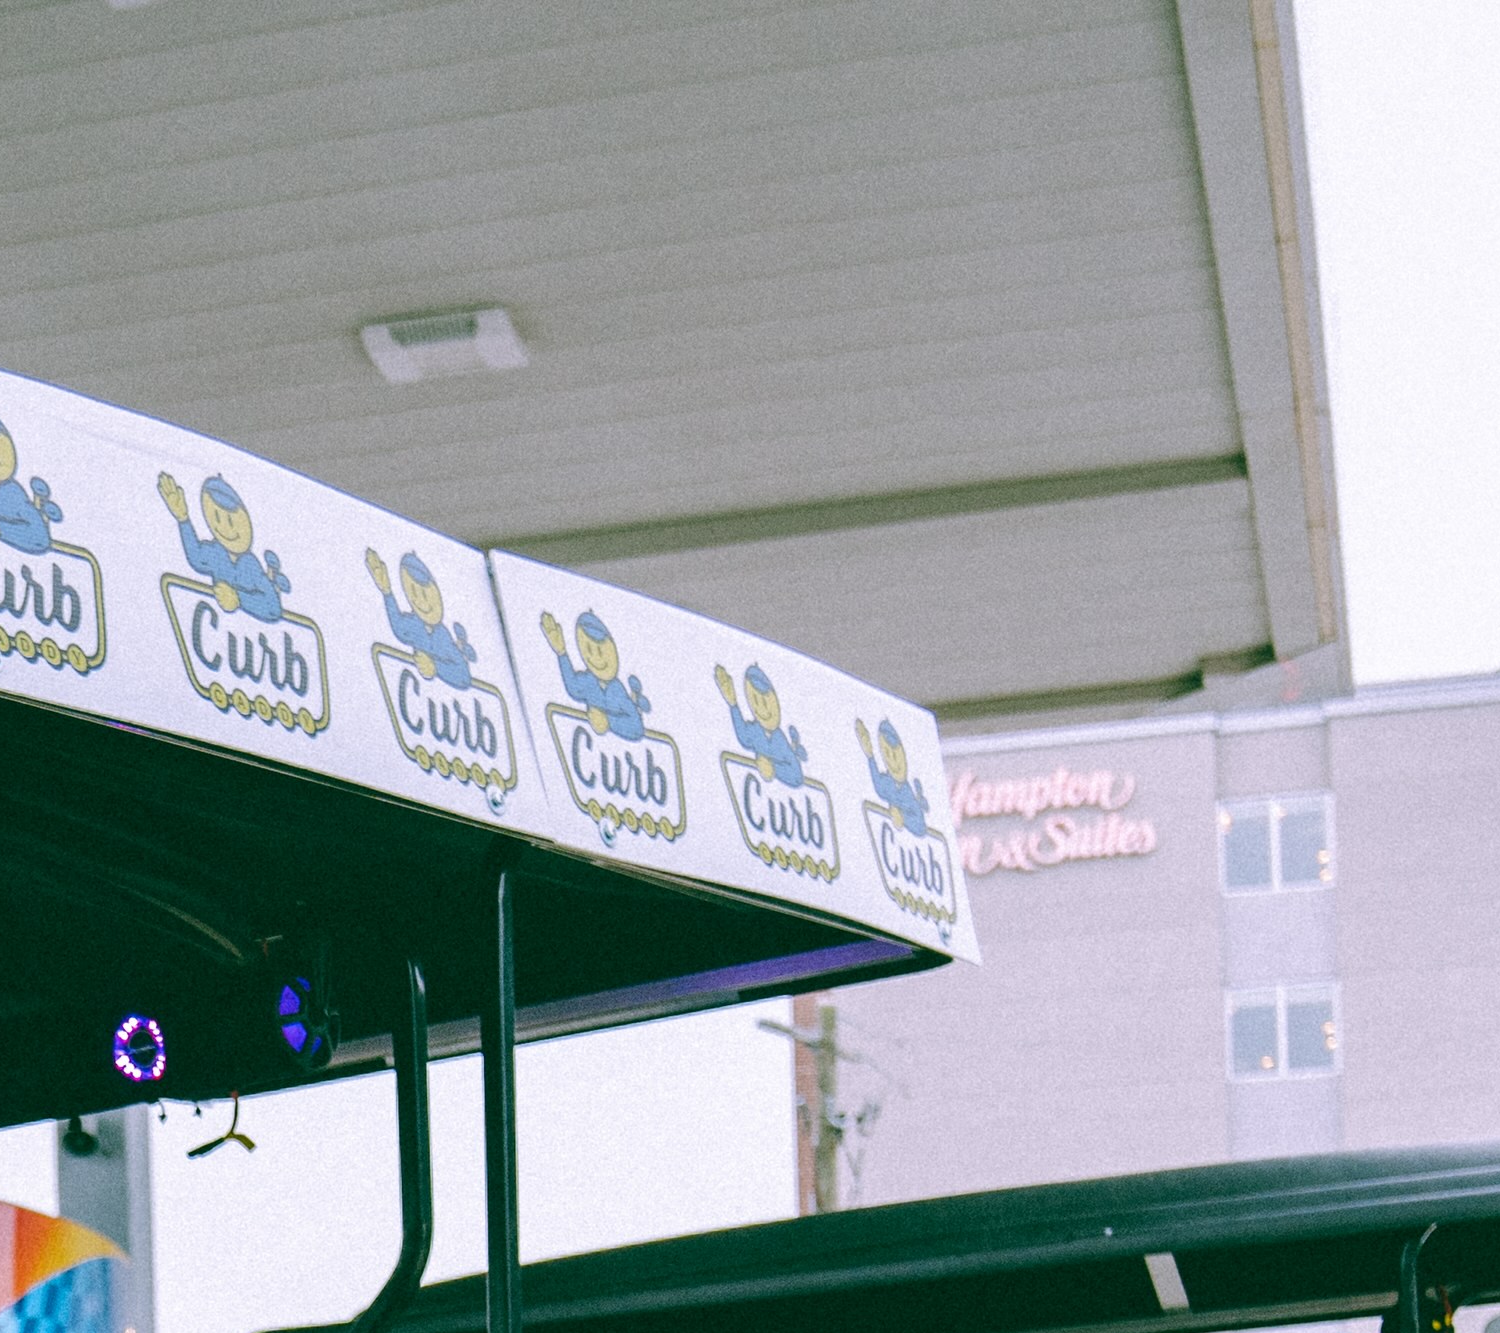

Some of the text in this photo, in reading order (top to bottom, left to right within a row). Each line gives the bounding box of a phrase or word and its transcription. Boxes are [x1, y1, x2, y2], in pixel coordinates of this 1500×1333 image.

[191, 600, 309, 698] Curb
[398, 668, 498, 759] Curb
[572, 725, 668, 807] Curb
[743, 772, 824, 850] Curb
[881, 821, 944, 896] Curb
